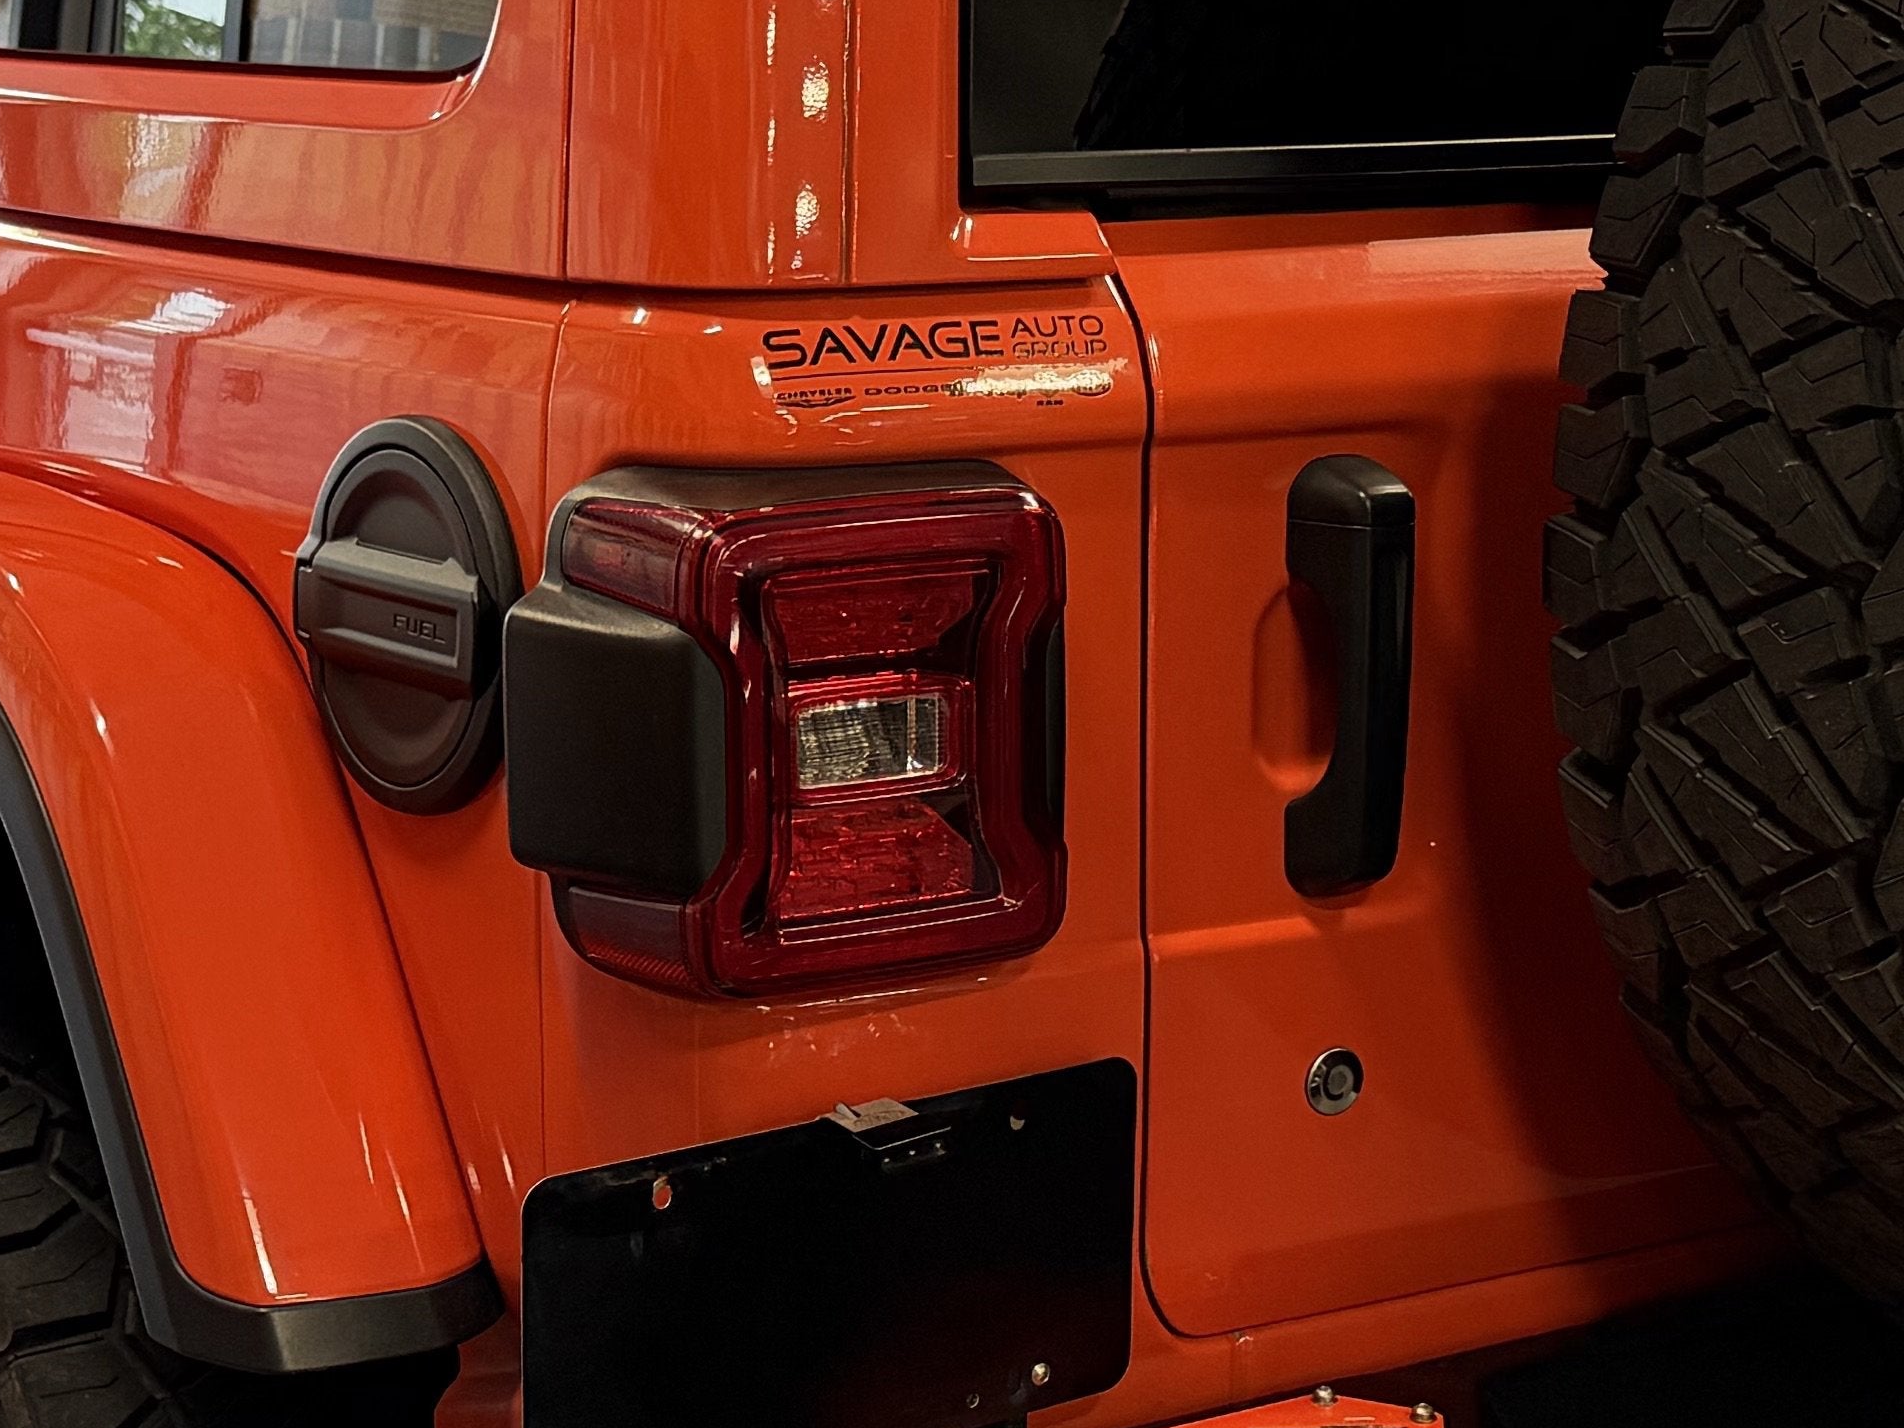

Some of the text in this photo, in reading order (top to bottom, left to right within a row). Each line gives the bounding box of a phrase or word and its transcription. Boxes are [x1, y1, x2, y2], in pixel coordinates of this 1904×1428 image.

[762, 314, 1104, 370] SAVAGE AUTO
[1012, 338, 1108, 359] GROUP
[393, 614, 446, 644] FUEL
